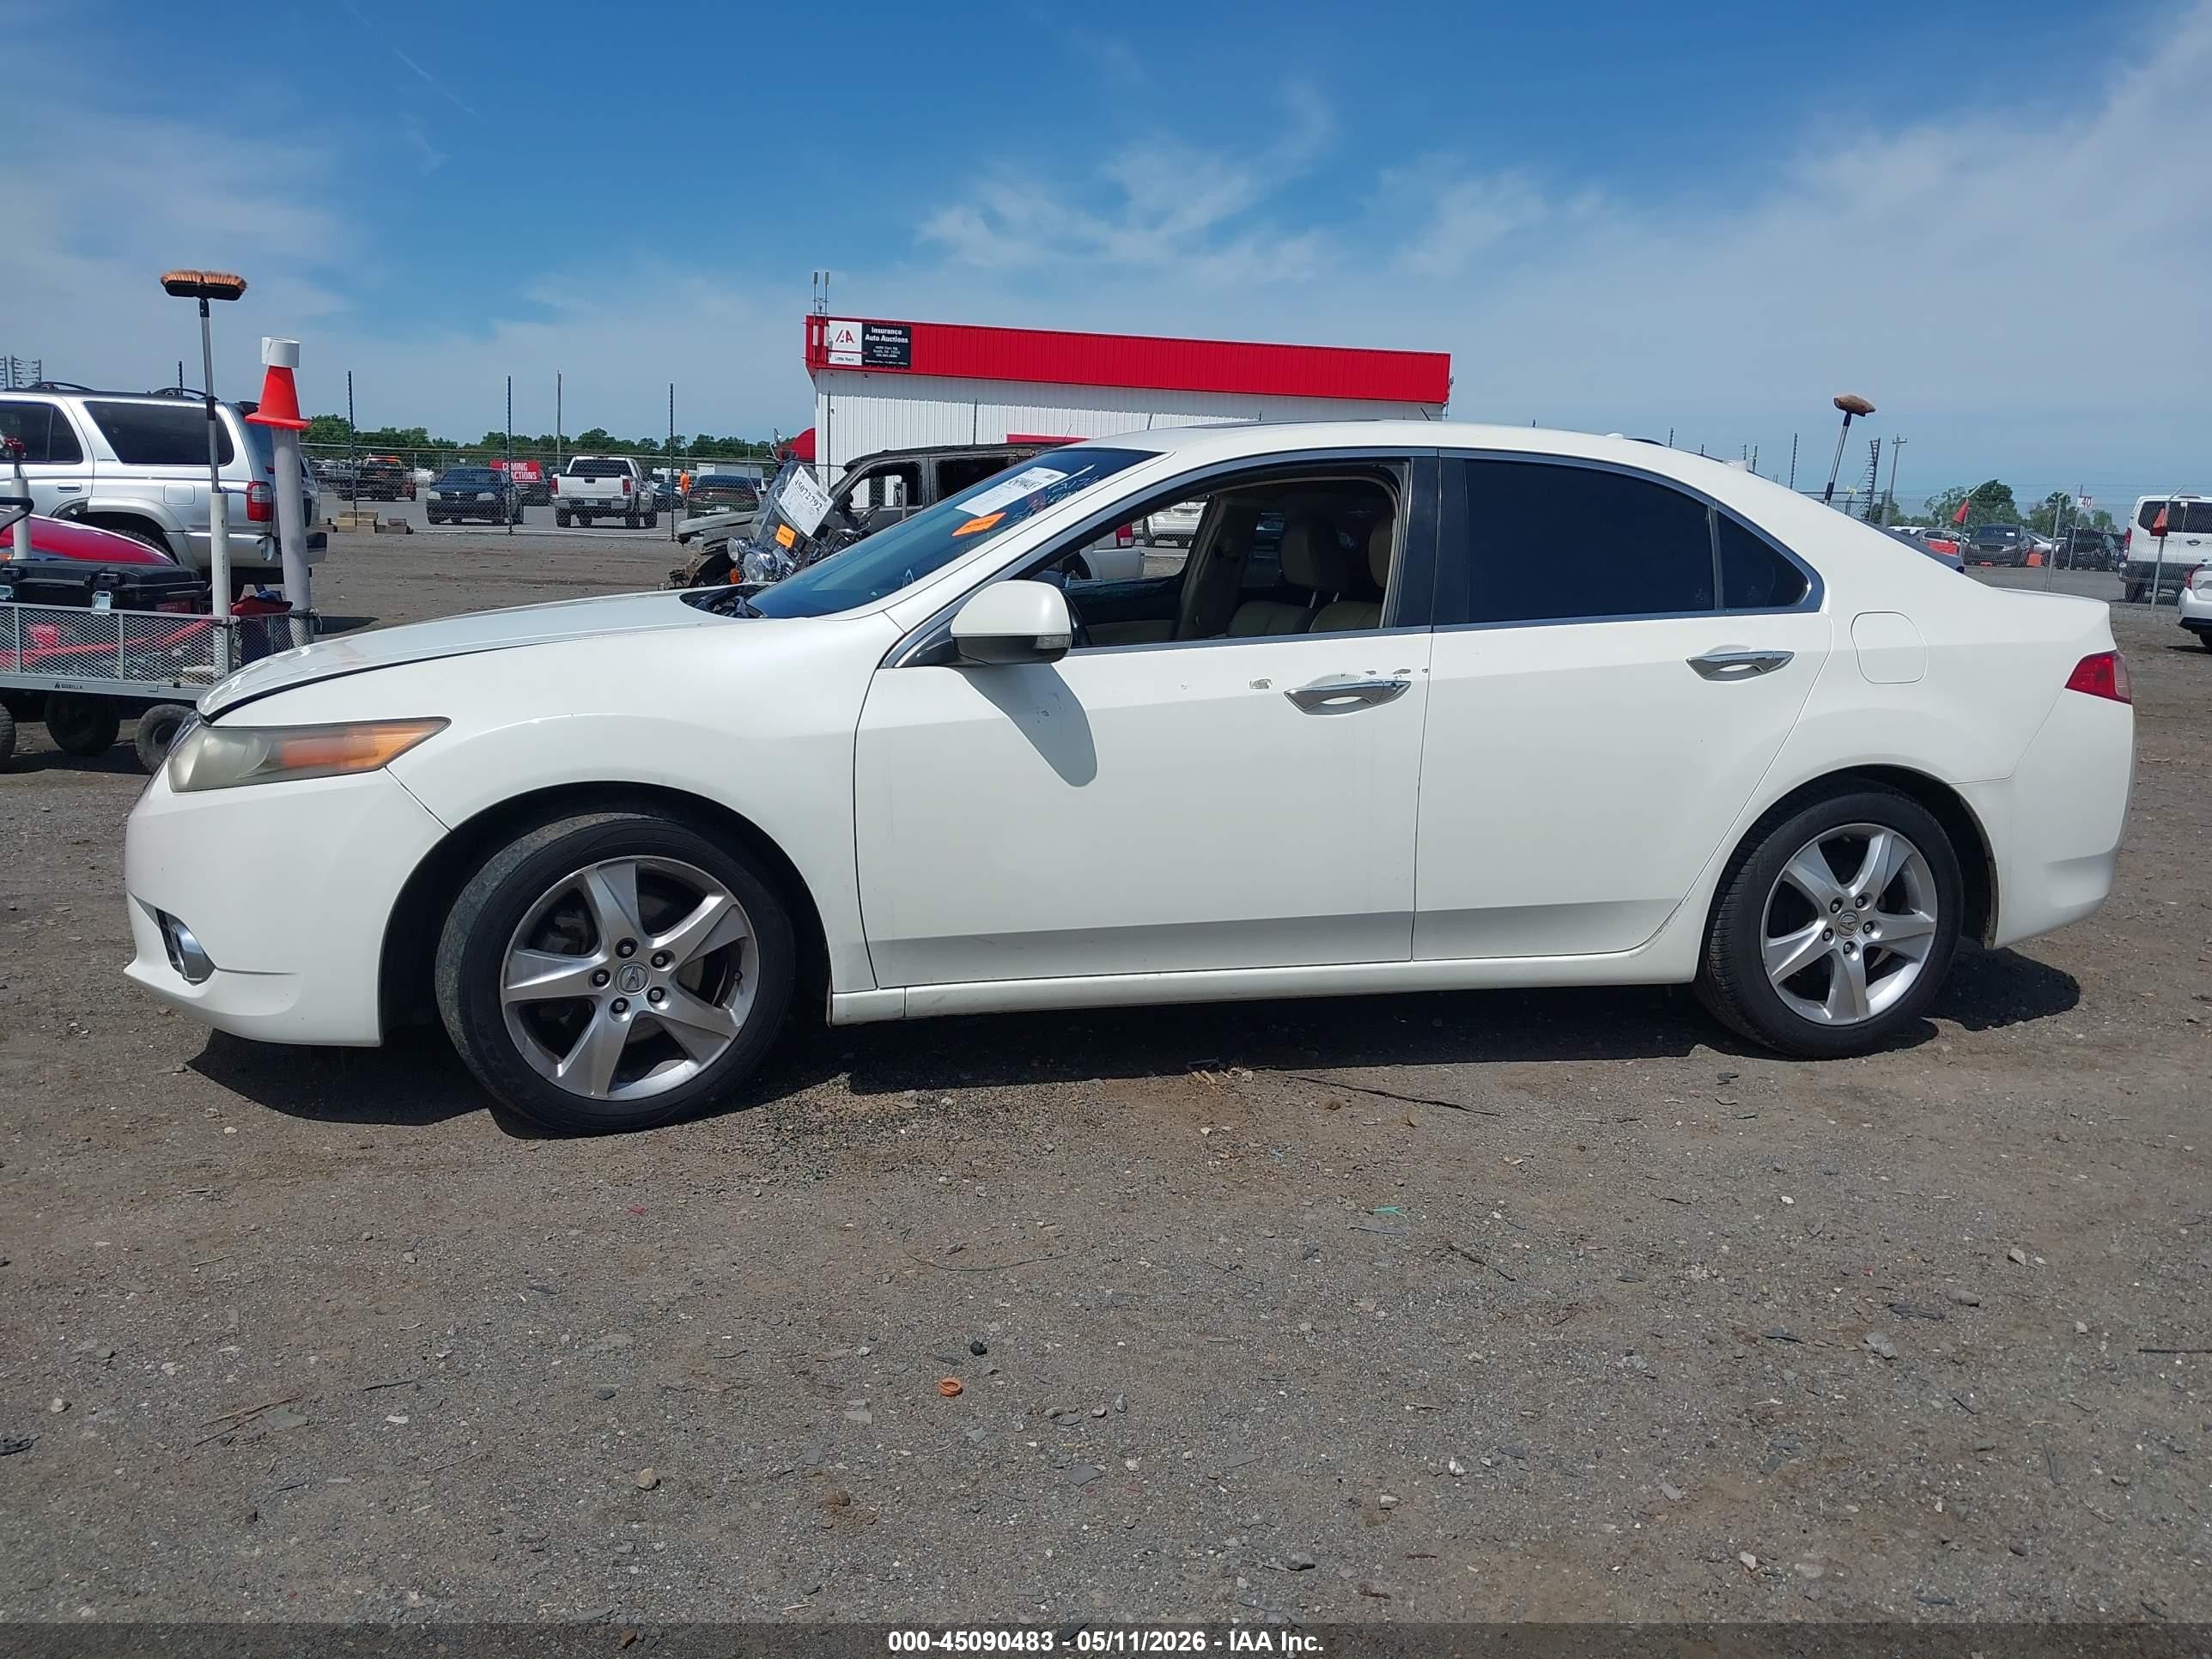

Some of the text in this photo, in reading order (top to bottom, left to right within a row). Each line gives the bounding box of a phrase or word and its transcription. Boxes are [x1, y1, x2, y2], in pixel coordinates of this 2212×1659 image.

[871, 326, 902, 335] Insurance
[880, 335, 909, 343] Auctions
[502, 462, 528, 471] COMING
[793, 479, 823, 512] 45072792
[2081, 496, 2093, 507] 40
